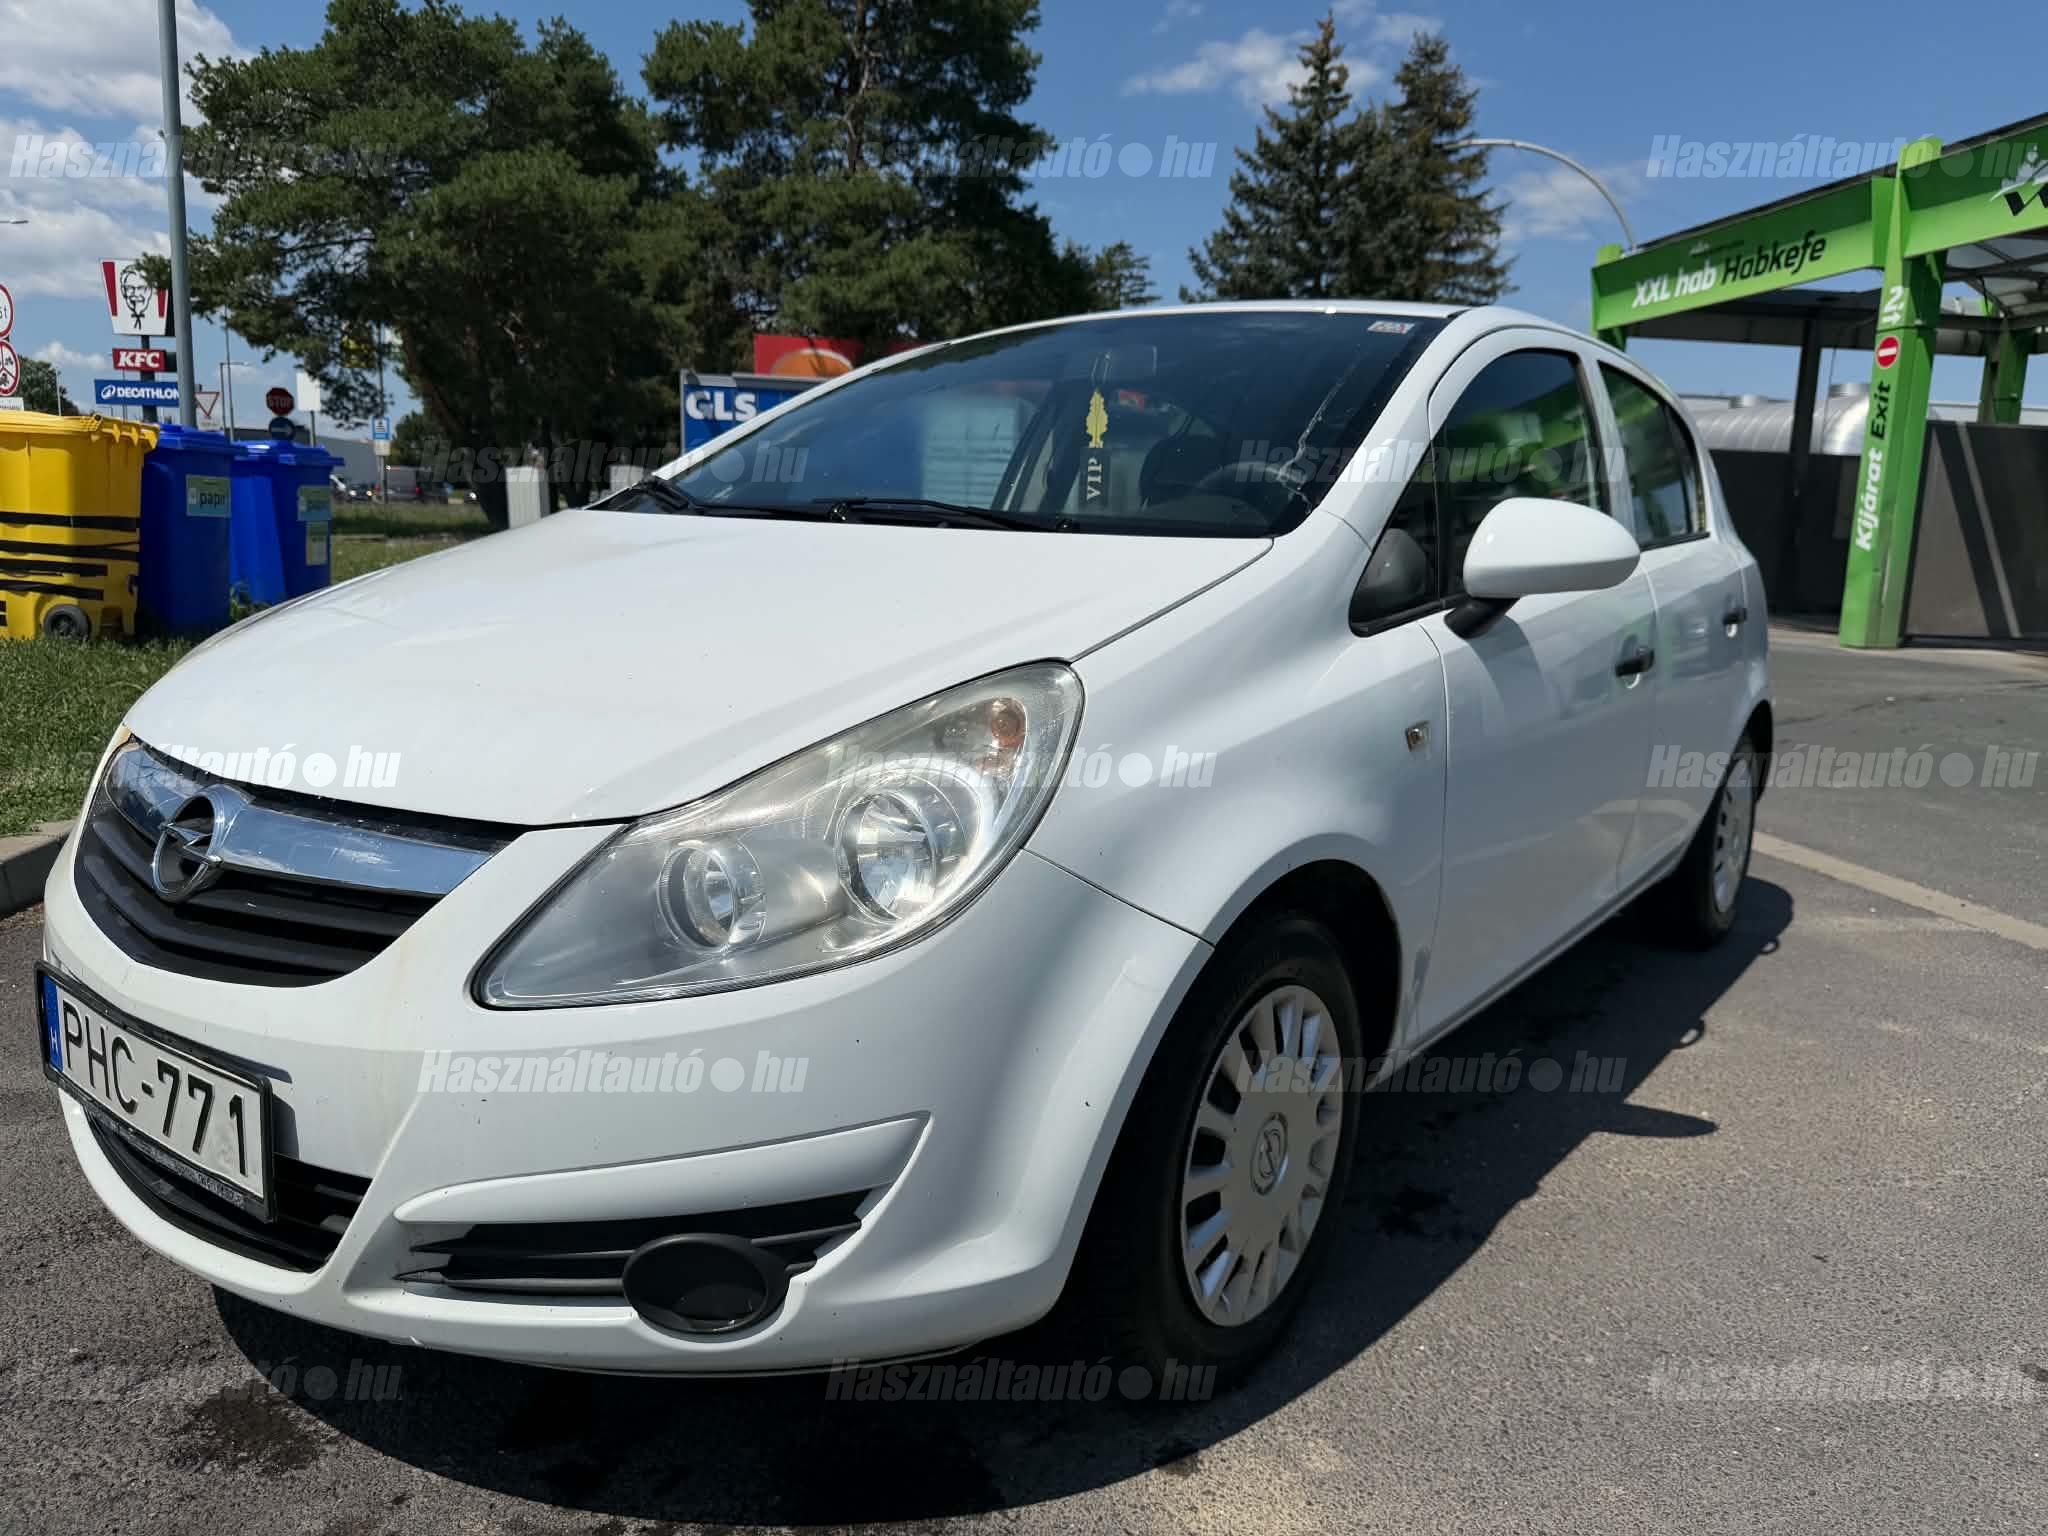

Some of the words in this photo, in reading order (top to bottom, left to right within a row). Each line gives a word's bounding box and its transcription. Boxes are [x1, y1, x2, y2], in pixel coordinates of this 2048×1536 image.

[1631, 273, 1672, 308] XXL
[1673, 259, 1718, 298] hab
[1721, 229, 1827, 285] Habkefe
[117, 351, 160, 368] KFC
[117, 386, 179, 401] DECATHLON
[685, 389, 757, 422] GLS
[1086, 456, 1103, 502] VIP
[1855, 447, 1884, 553] Kijárat
[1870, 380, 1892, 441] Exit
[63, 999, 249, 1178] PHC-771
